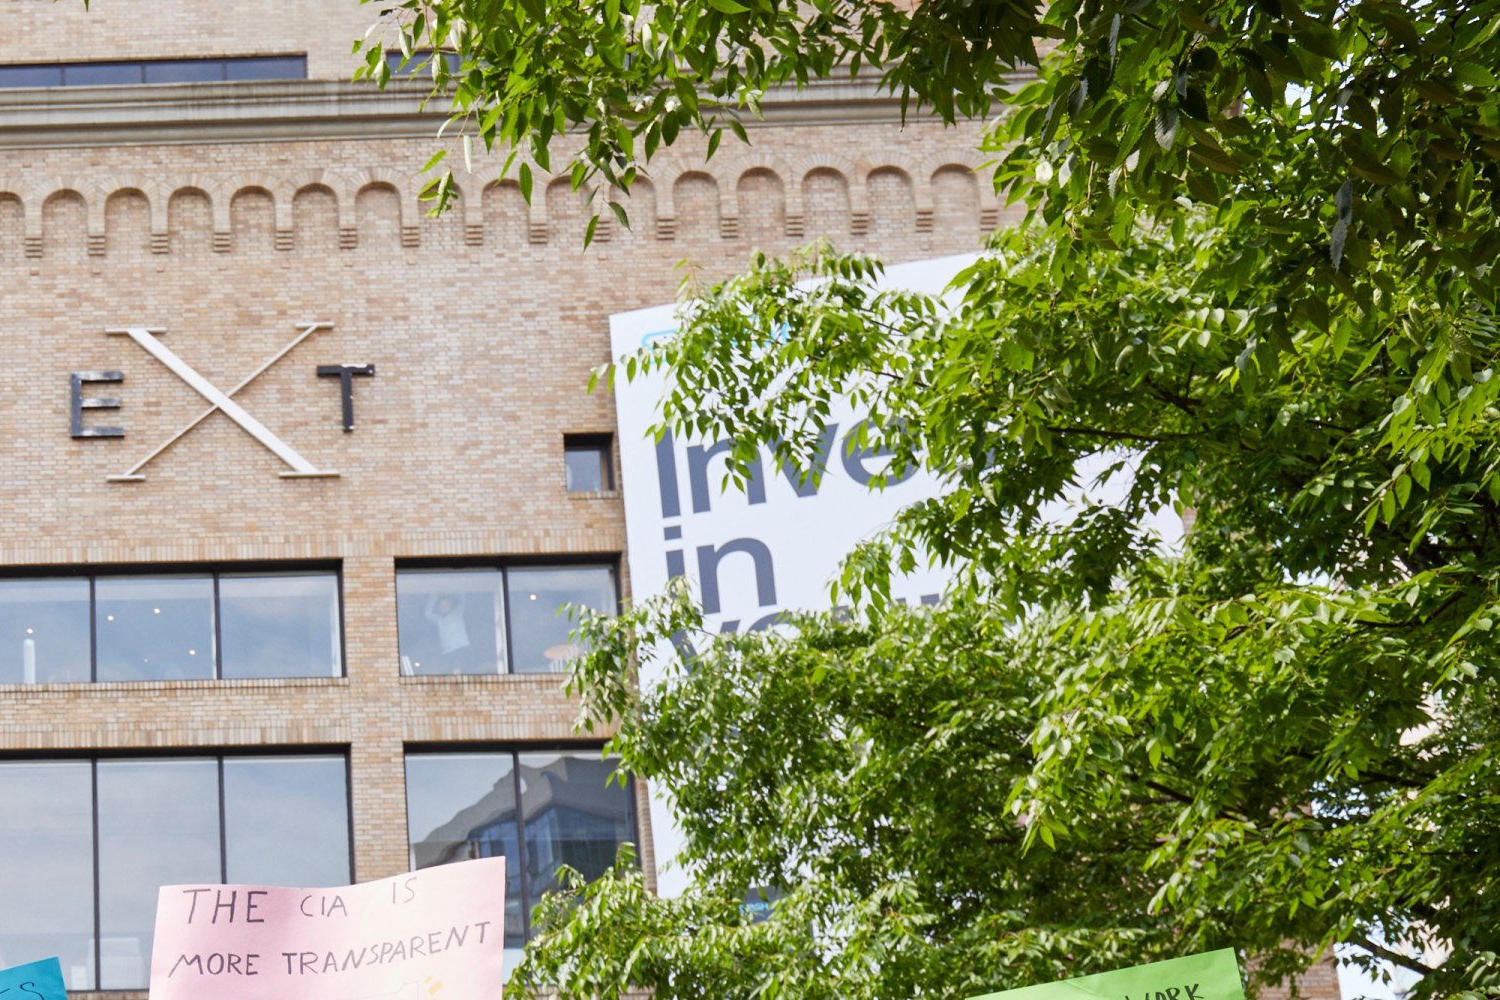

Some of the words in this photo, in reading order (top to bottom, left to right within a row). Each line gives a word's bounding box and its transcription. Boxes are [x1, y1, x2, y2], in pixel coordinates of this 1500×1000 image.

[663, 525, 777, 615] in
[183, 888, 268, 924] THE
[300, 893, 348, 918] CIA
[392, 876, 417, 905] IS
[168, 952, 261, 979] MORE
[281, 919, 492, 977] TRANSPARENT
